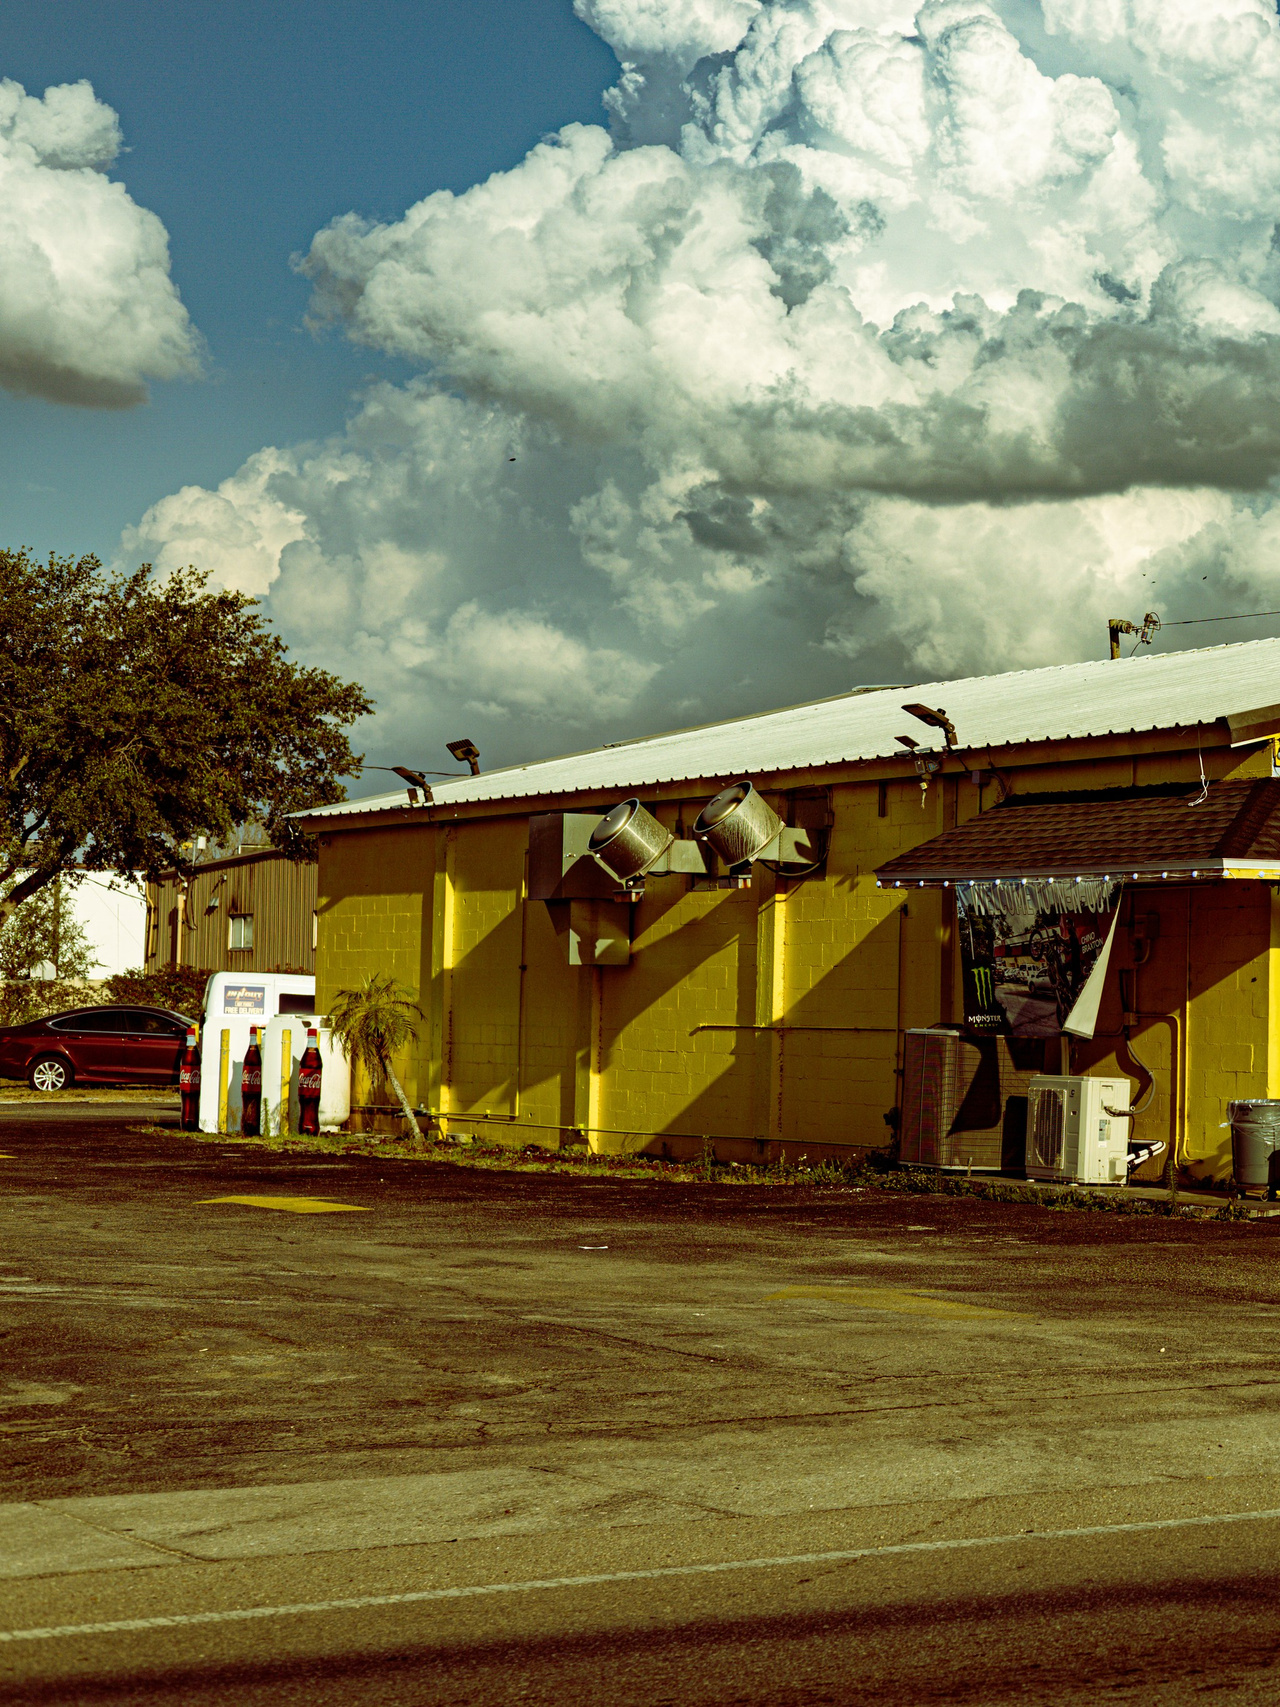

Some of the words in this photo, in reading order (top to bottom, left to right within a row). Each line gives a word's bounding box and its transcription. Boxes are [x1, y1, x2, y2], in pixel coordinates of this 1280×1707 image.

[971, 880, 1035, 916] WELCOME
[225, 1006, 238, 1014] FREE
[968, 1014, 1002, 1024] MONSTER
[299, 1073, 321, 1089] Coca-Cola
